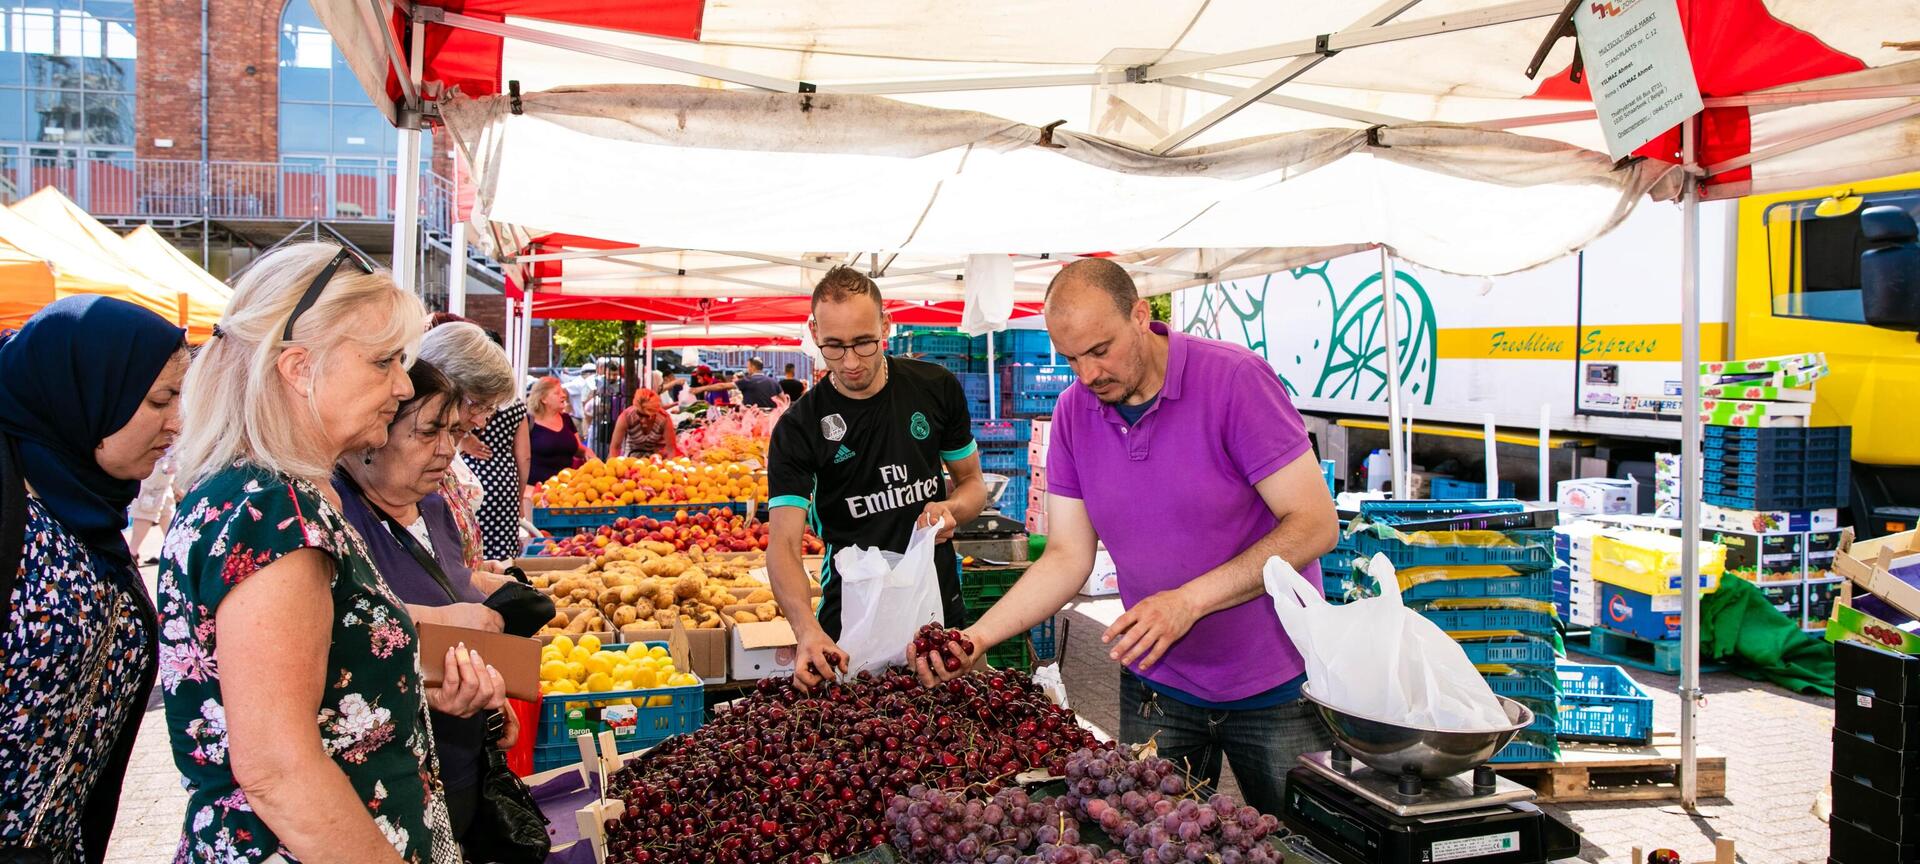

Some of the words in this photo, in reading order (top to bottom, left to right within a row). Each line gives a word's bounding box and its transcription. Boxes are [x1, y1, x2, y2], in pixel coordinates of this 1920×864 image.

[1638, 11, 1657, 28] MARKT
[1605, 42, 1637, 68] STANDPLAATS
[1601, 71, 1618, 86] YILMAZ
[1618, 61, 1634, 75] Ahmet
[1619, 74, 1637, 89] YILMAZ
[1637, 63, 1654, 78] Ahmet
[1489, 331, 1564, 355] Freshline
[1579, 330, 1657, 357] Express
[1638, 399, 1683, 410] LAMERET
[833, 450, 857, 464] adidas
[879, 464, 908, 484] Fly
[845, 475, 938, 519] Emirates
[568, 728, 591, 736] Baron
